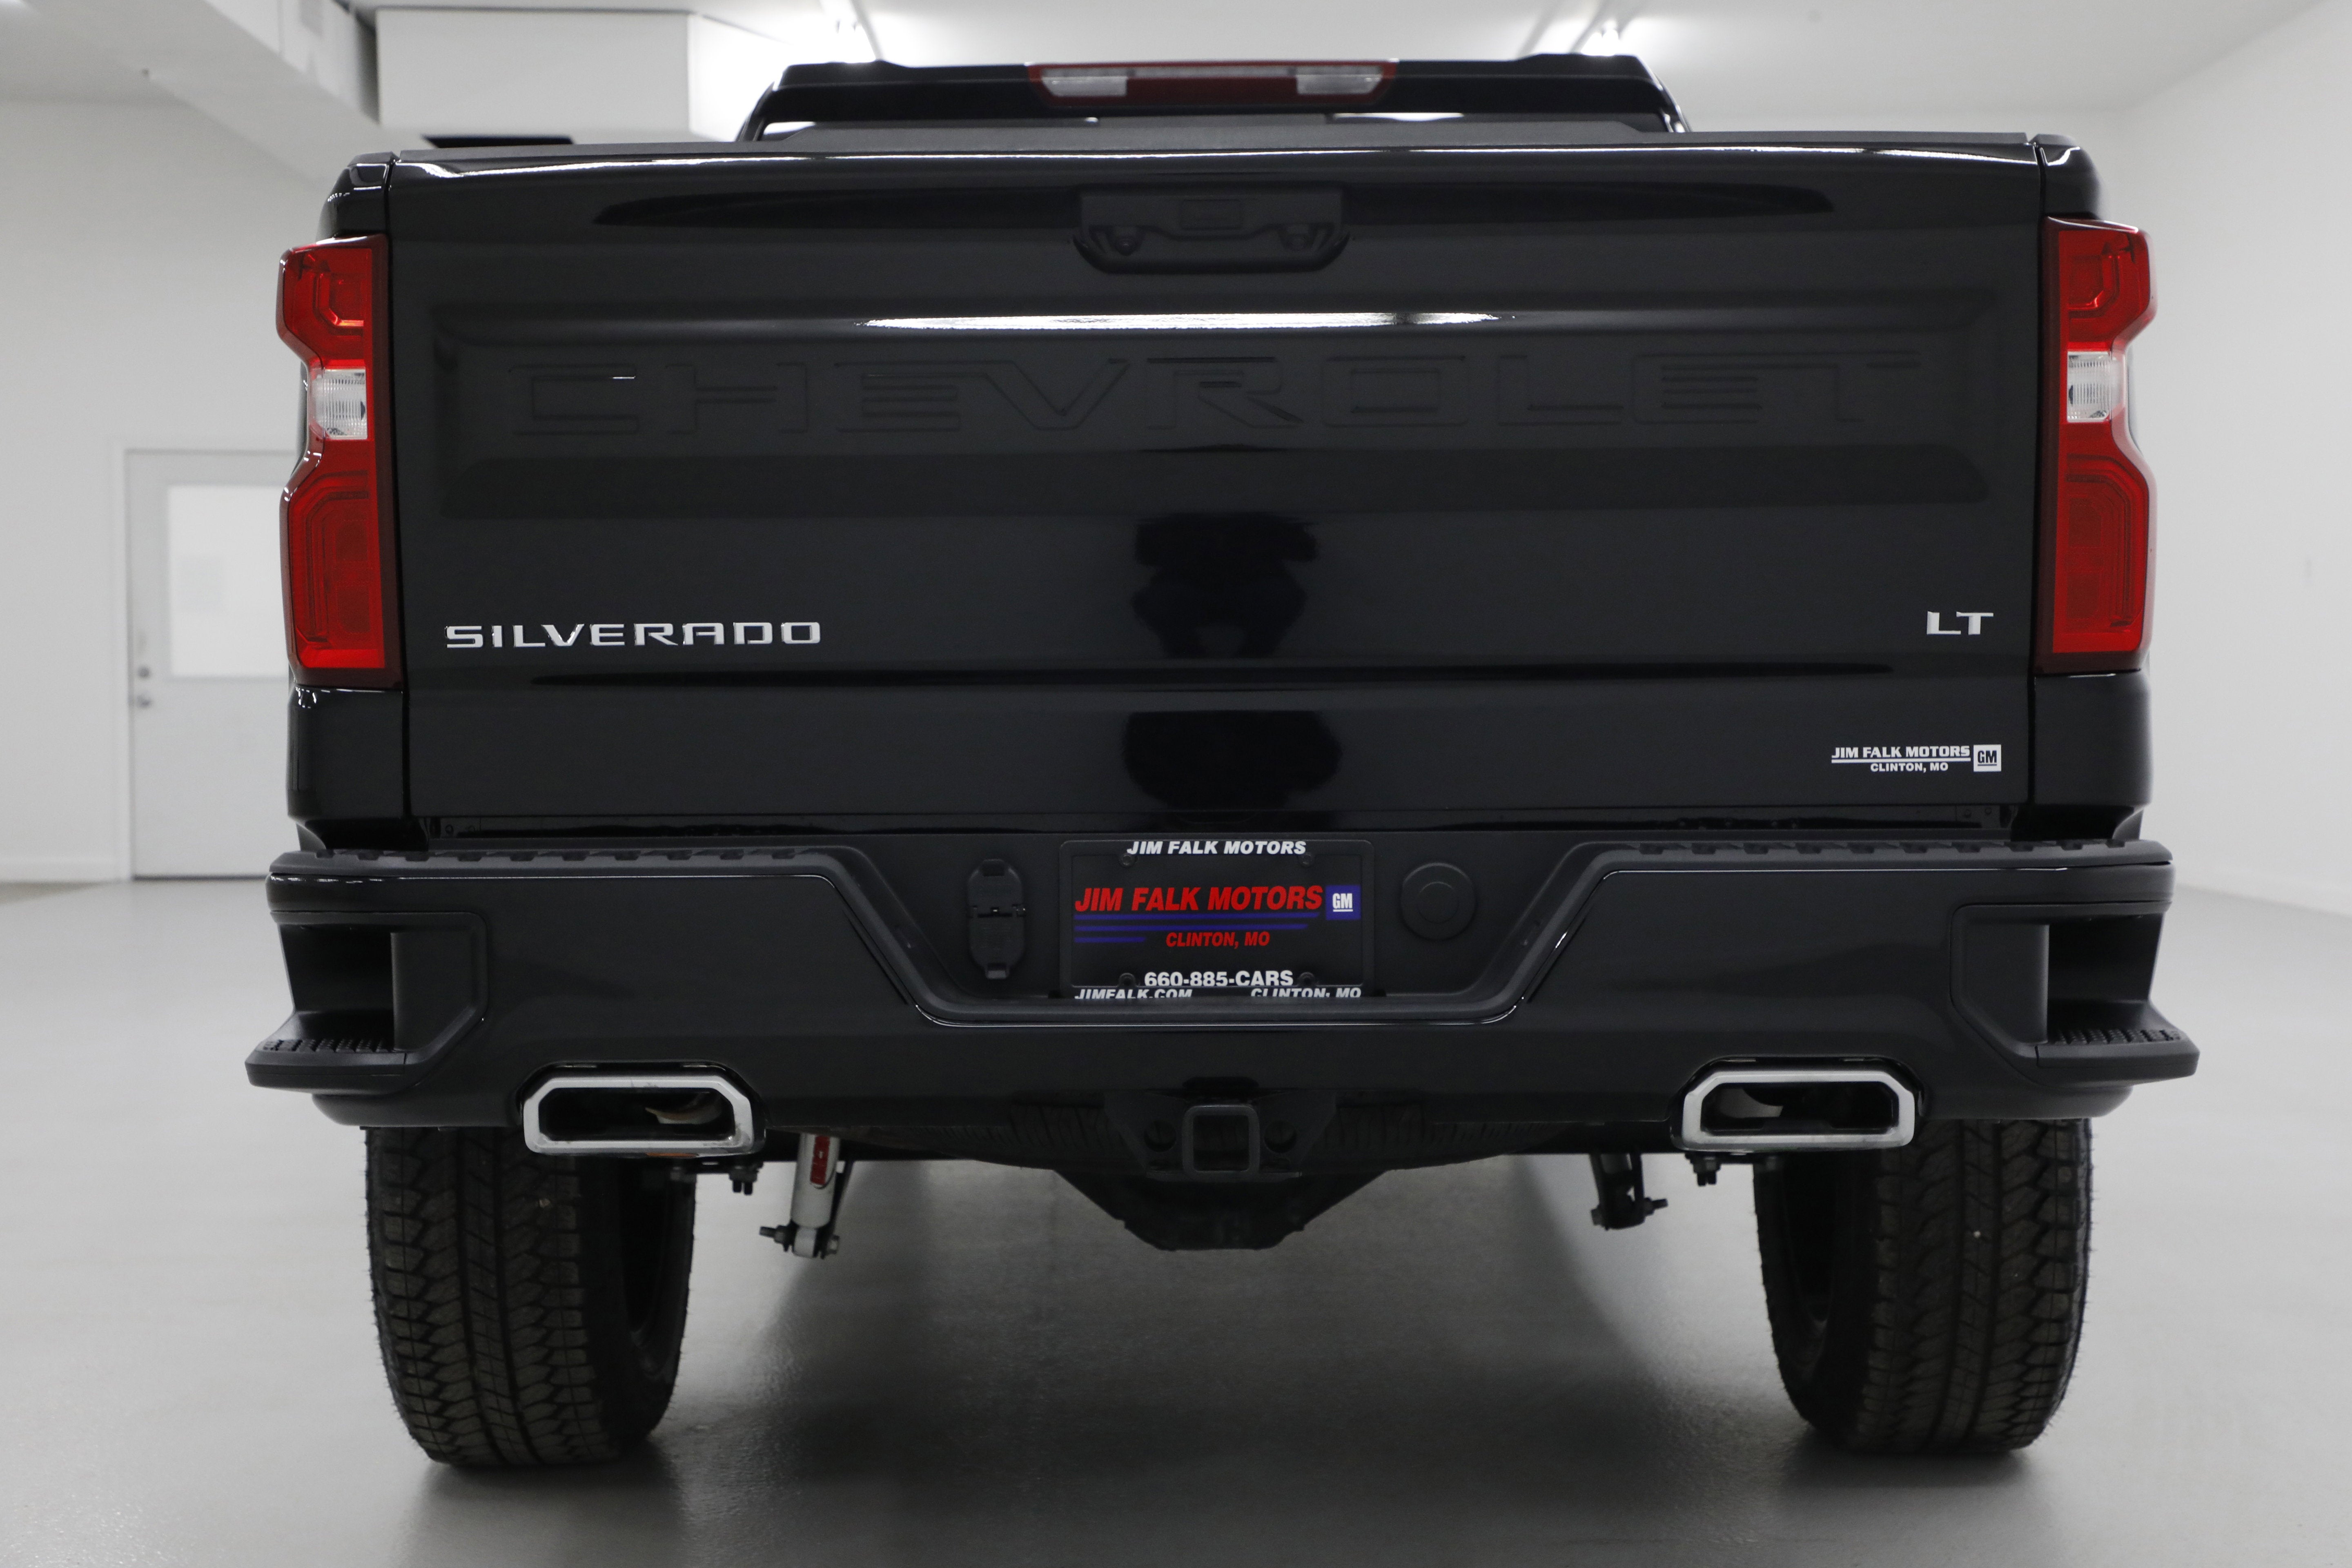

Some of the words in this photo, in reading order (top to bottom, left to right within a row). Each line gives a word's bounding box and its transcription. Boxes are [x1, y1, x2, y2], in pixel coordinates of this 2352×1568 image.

[507, 350, 1920, 436] CHEVROLET
[1926, 611, 1994, 635] LT
[445, 621, 821, 648] SILVERADO
[1831, 747, 1859, 759] JIM
[1862, 746, 1902, 758] FALK
[1905, 746, 1970, 757] MOTORS
[1977, 750, 1998, 764] GM
[1870, 763, 1927, 773] CLINTON,
[1930, 762, 1949, 772] MO
[1126, 841, 1163, 855] JIM
[1167, 841, 1219, 854] FALK
[1223, 840, 1307, 855] MOTORS
[1074, 888, 1123, 911] JIM
[1131, 887, 1201, 911] FALK
[1207, 885, 1323, 911] MOTORS
[1332, 893, 1353, 909] GM
[1165, 932, 1239, 949] CLINTON,
[1244, 931, 1270, 946] MO
[1144, 970, 1294, 987] 660-885-CARS
[1074, 989, 1193, 999] JIMFALK.COM
[1335, 987, 1362, 998] MO
